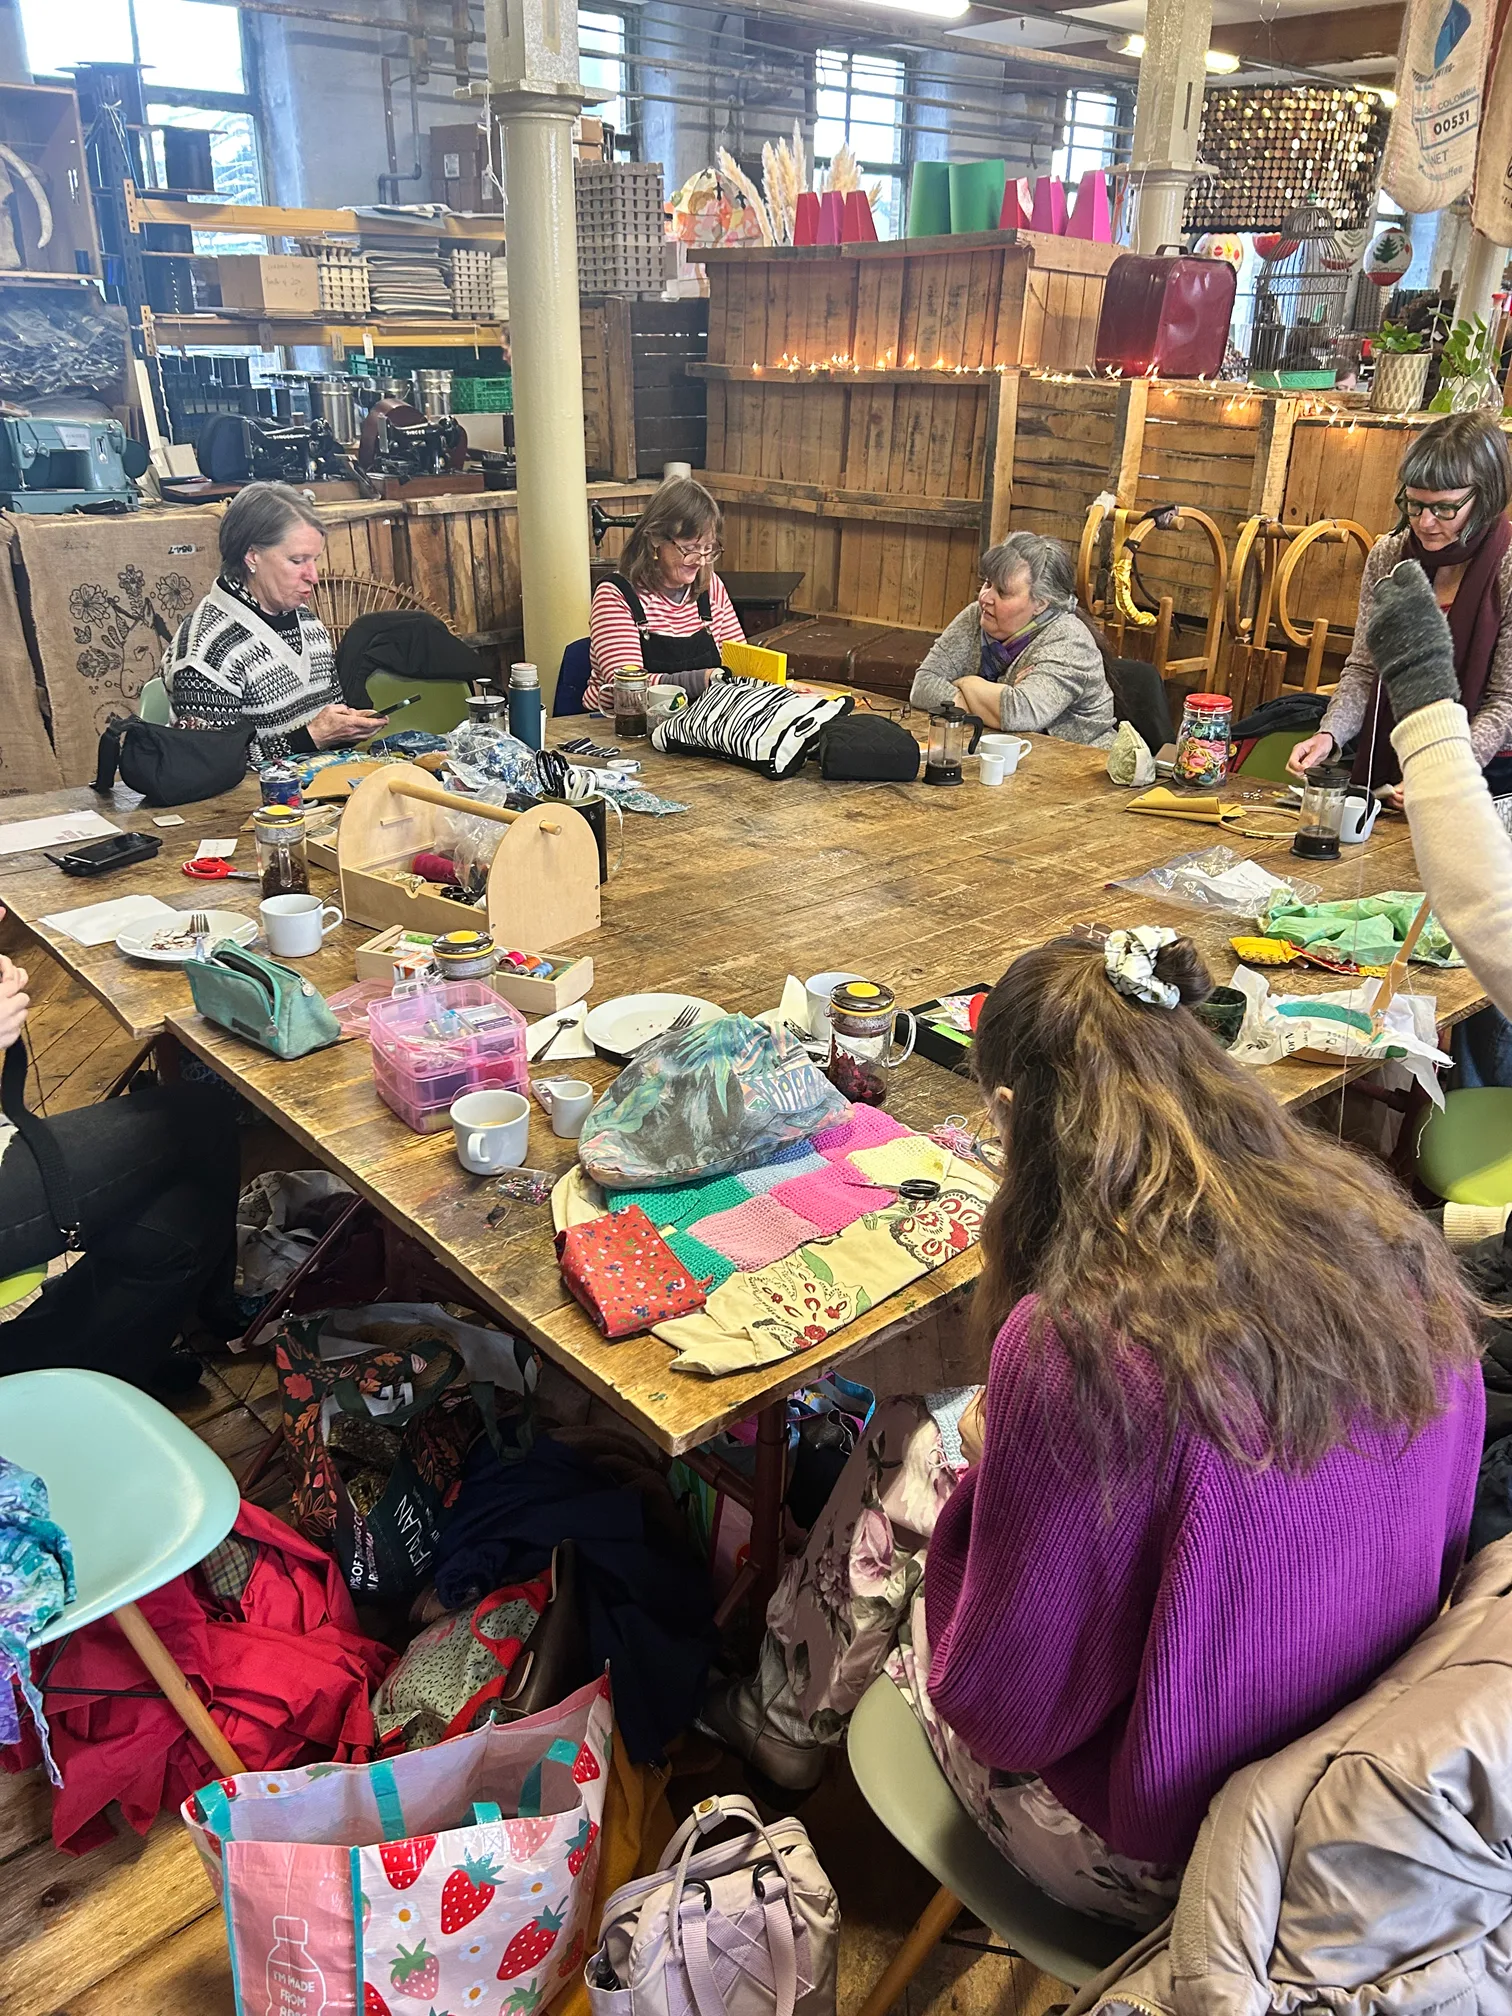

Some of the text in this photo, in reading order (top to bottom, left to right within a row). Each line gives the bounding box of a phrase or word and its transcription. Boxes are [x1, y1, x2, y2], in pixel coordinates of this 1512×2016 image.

[1438, 86, 1476, 110] COLOMBIA
[1433, 110, 1470, 135] 00531
[351, 1560, 365, 1576] OF
[273, 1970, 315, 1993] I'M MADE
[280, 1988, 307, 2009] FROM
